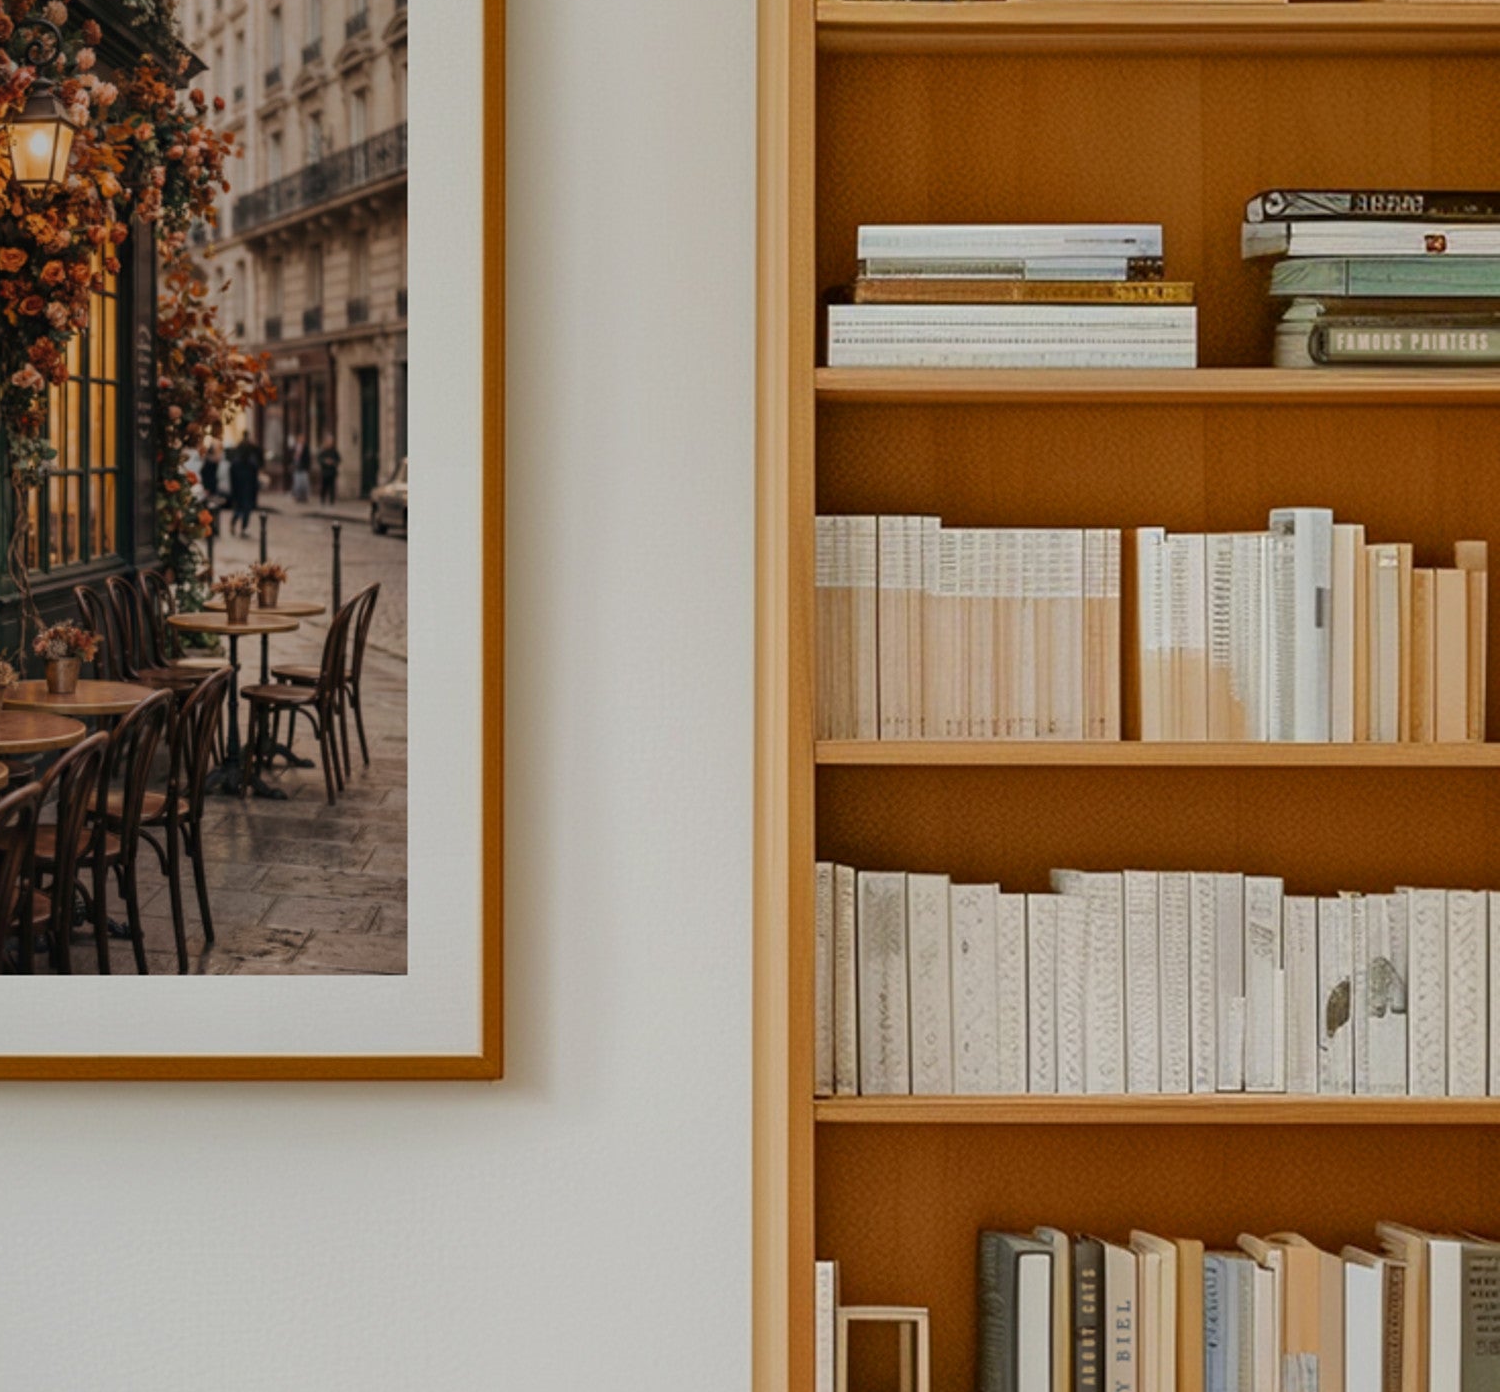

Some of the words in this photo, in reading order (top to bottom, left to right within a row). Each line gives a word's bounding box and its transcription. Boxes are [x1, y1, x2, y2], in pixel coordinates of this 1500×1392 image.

[1336, 333, 1403, 351] FAMOUS
[1410, 333, 1489, 351] PAINTERS
[1081, 1268, 1097, 1314] CATS
[1081, 1328, 1096, 1386] ABOUT
[1115, 1300, 1131, 1362] BIEL
